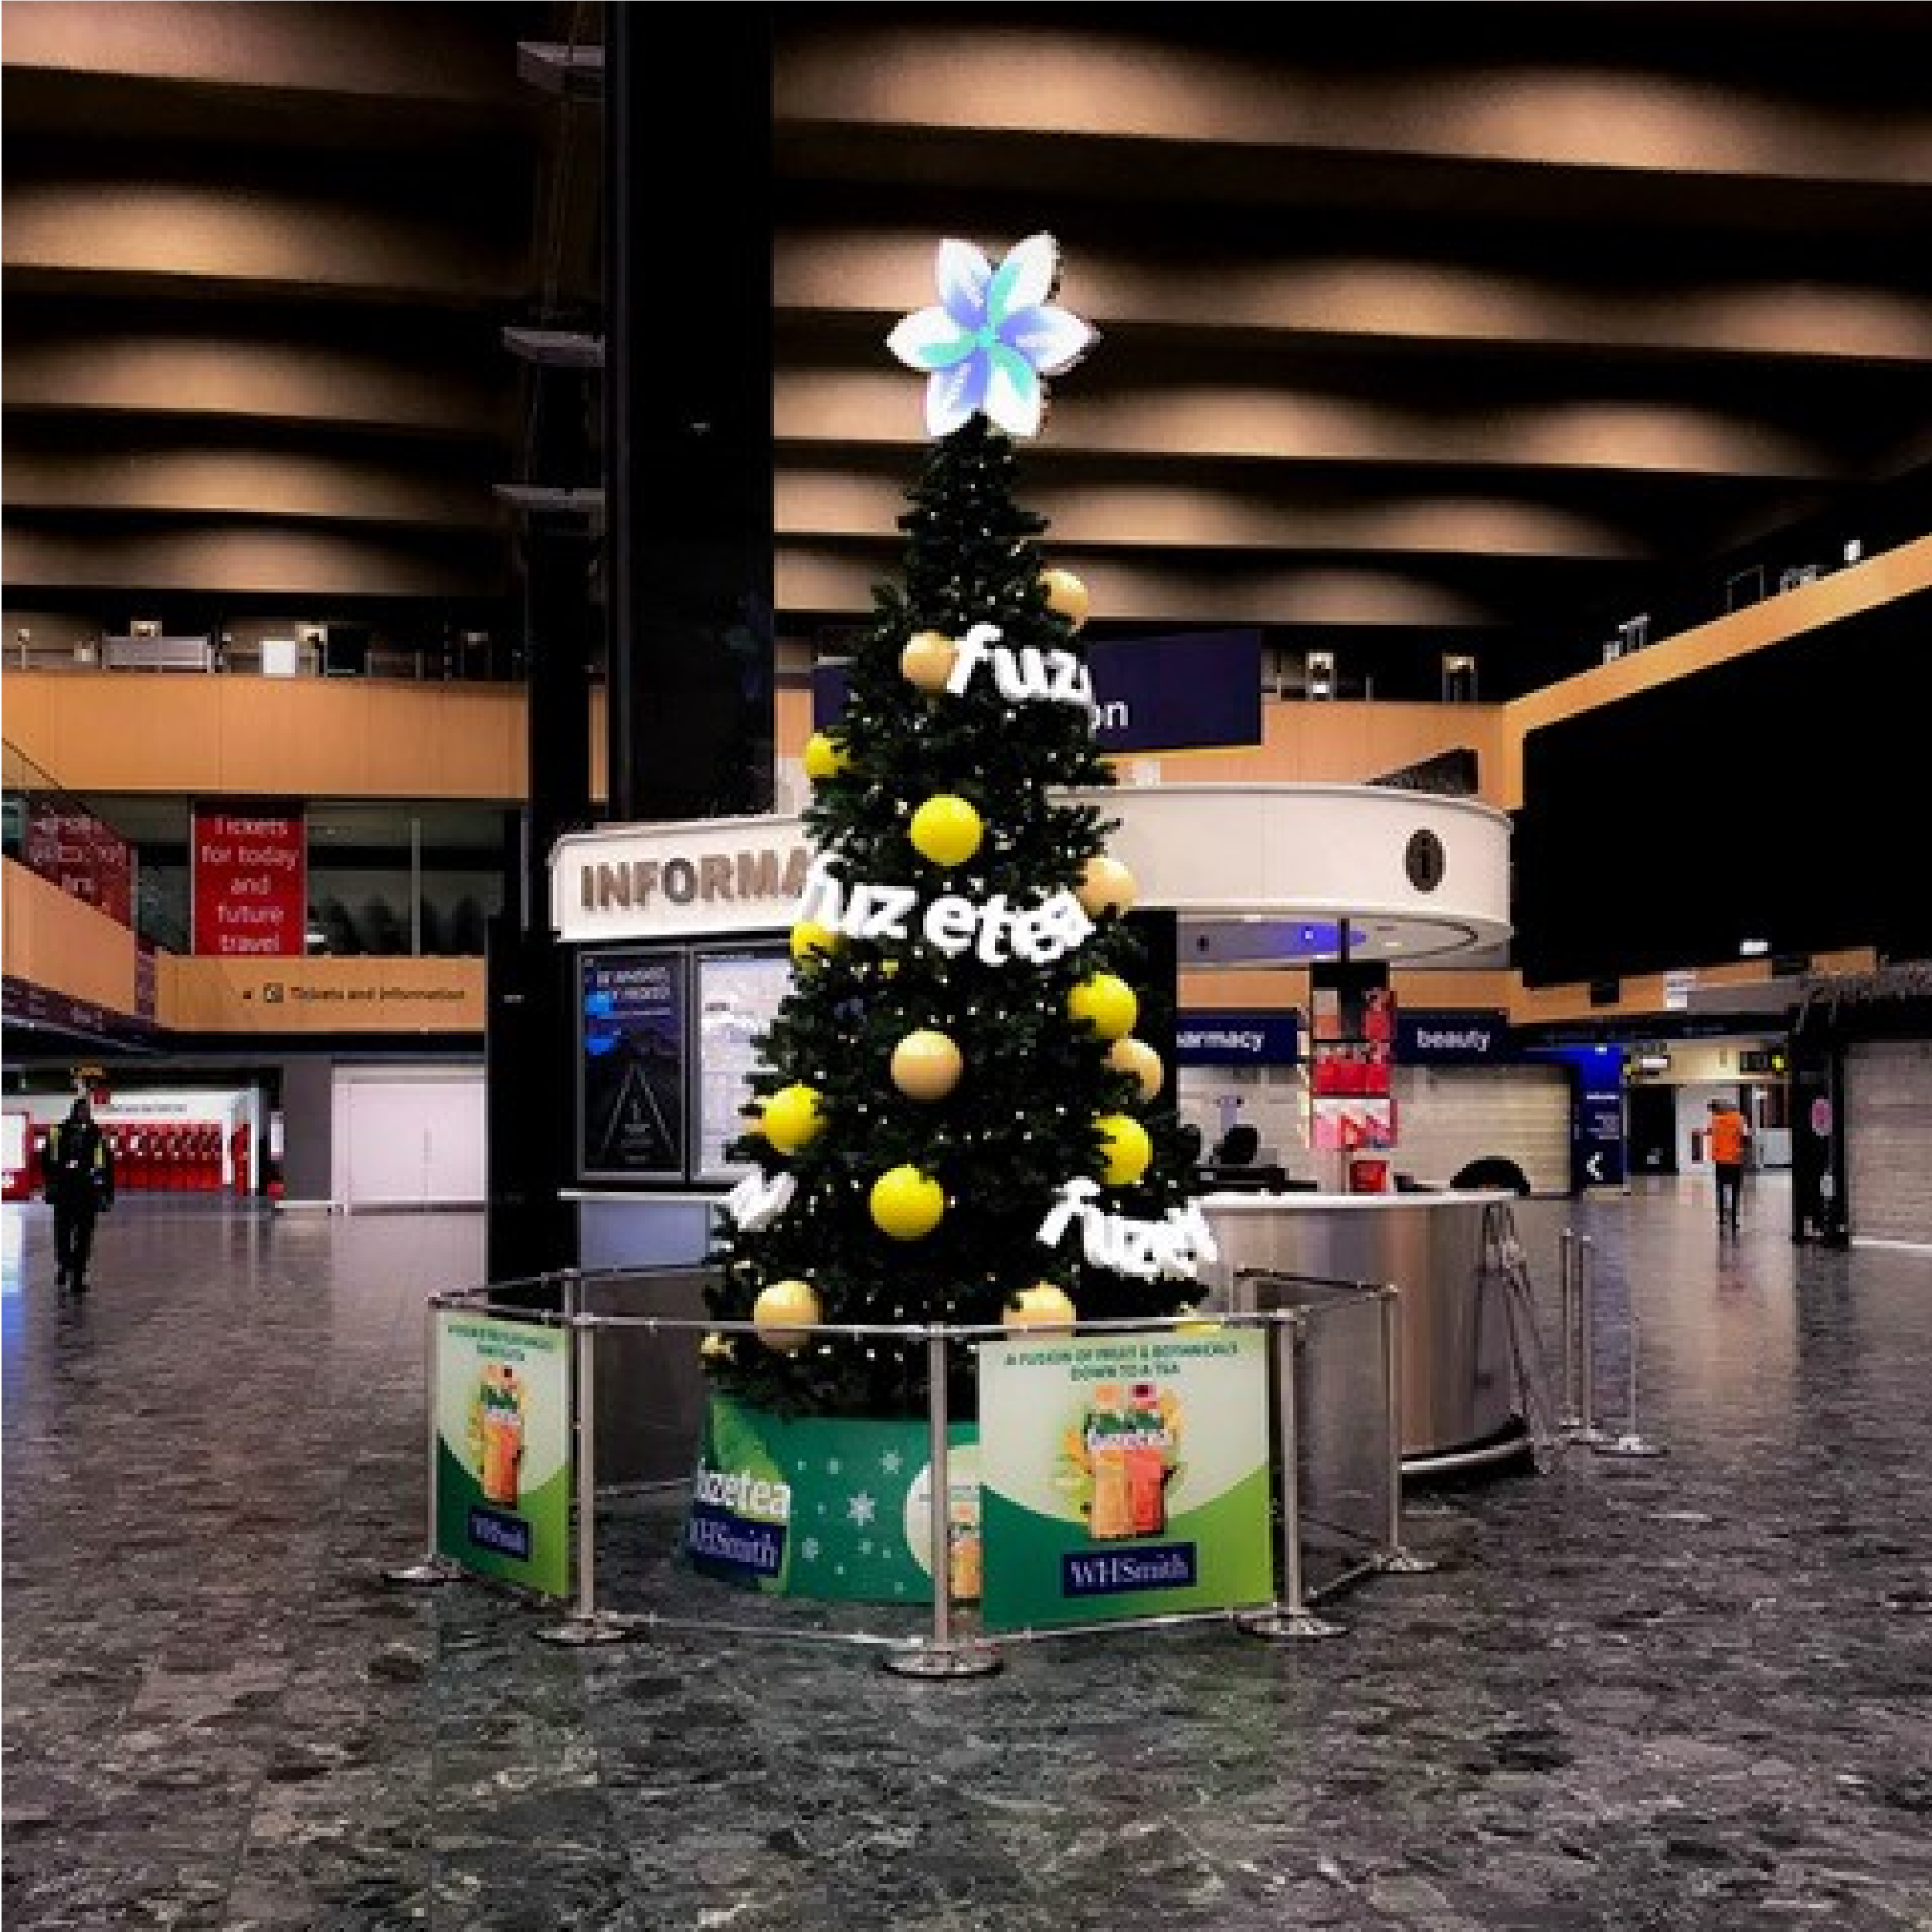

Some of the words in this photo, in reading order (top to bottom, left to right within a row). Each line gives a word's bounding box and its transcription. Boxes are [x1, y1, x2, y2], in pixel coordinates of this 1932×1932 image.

[202, 845, 233, 865] for
[238, 845, 298, 871] today
[229, 874, 270, 895] and
[217, 904, 284, 924] future
[219, 932, 280, 952] travel
[1416, 1028, 1491, 1052] beauty
[1070, 1553, 1190, 1587] WHSmith
